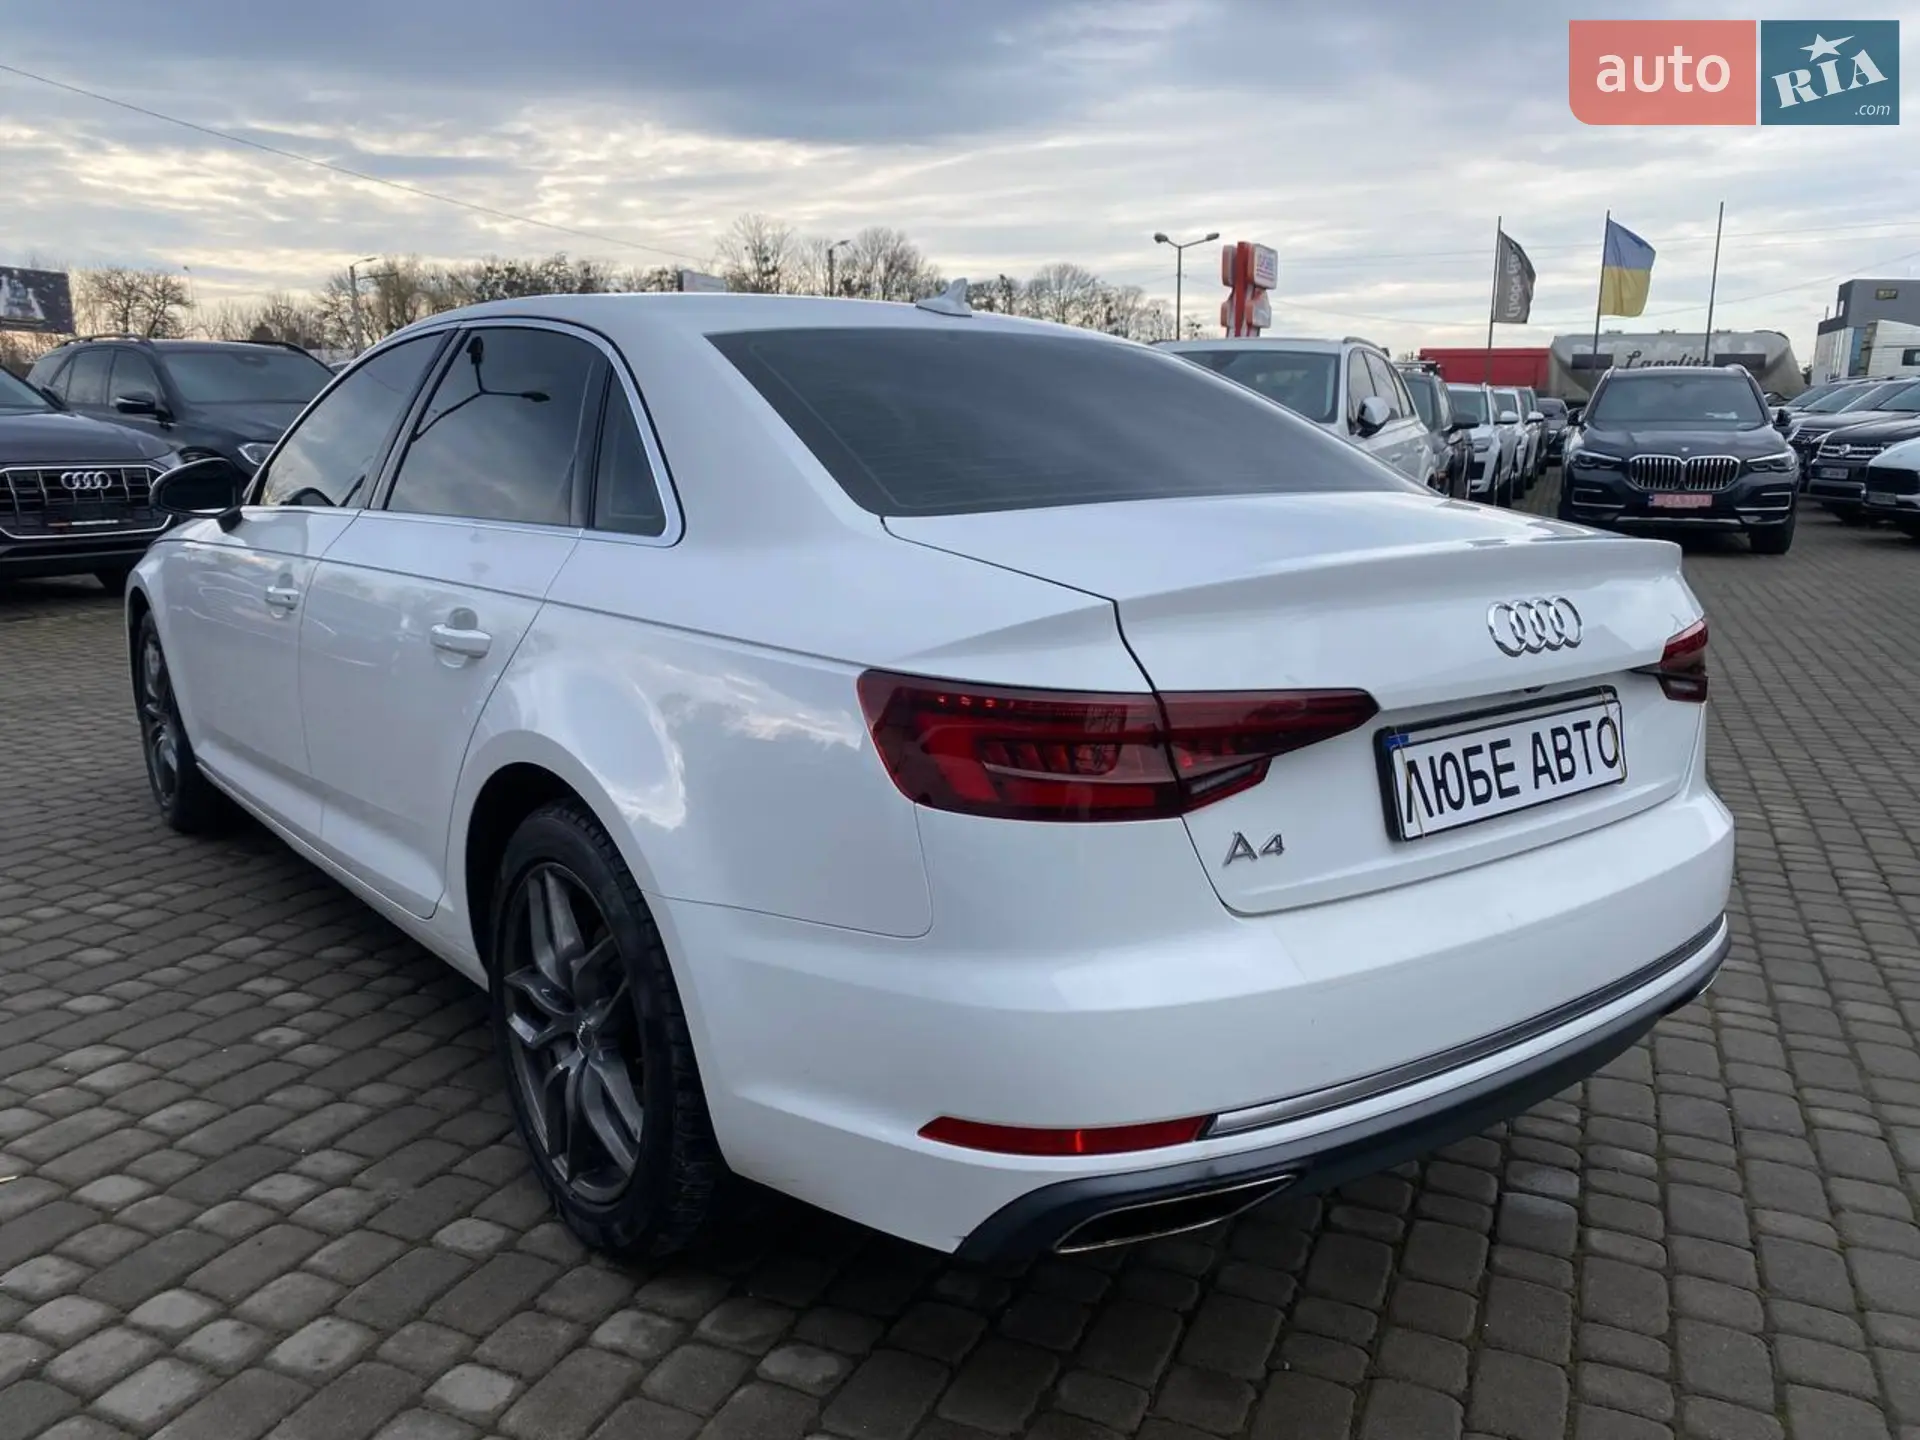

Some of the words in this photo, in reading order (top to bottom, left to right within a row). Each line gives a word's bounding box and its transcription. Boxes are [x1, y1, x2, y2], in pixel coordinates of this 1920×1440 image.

[1406, 738, 1521, 824] ЛЮБЕ
[1530, 715, 1620, 790] АВТО
[1223, 831, 1285, 868] A4
